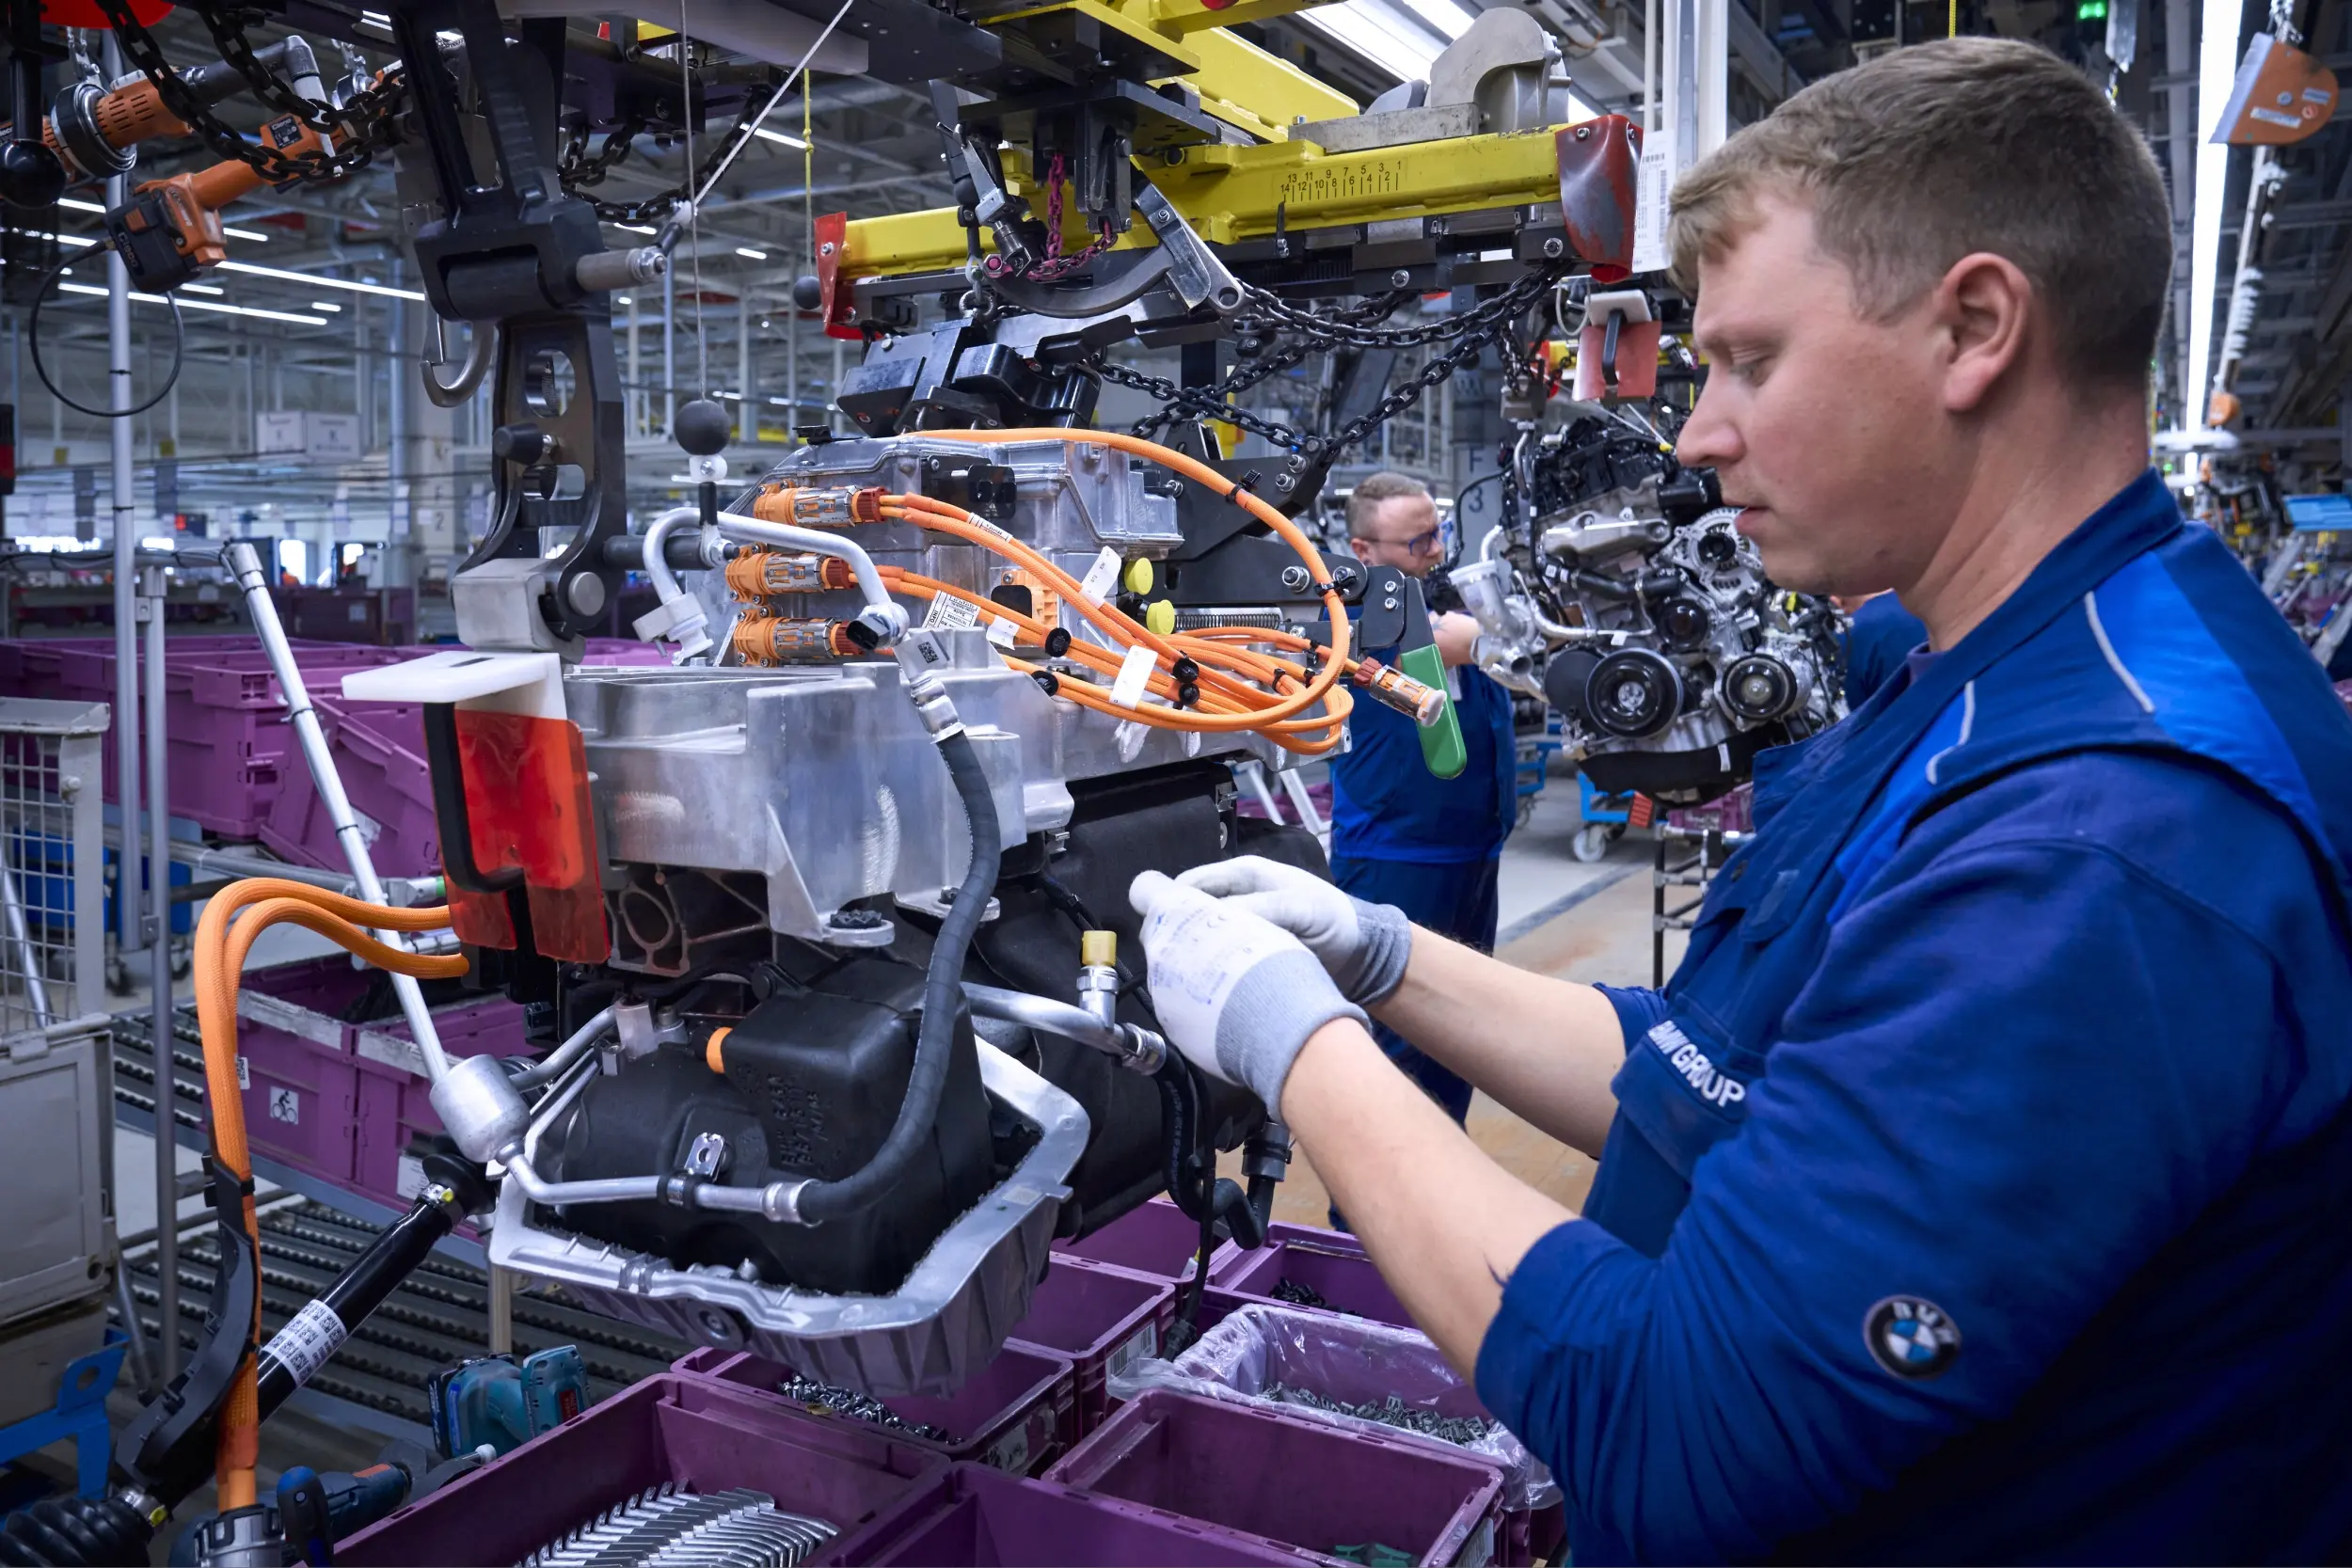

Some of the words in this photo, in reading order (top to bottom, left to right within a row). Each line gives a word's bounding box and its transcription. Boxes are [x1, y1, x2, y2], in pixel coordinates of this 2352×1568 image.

[1280, 184, 1290, 193] 14
[1297, 182, 1307, 191] 12
[1315, 180, 1325, 189] 10
[1332, 178, 1338, 187] 8
[1349, 176, 1355, 185] 6
[1367, 173, 1373, 182] 4
[1385, 171, 1391, 181] 2
[1288, 174, 1297, 182] 13
[1305, 171, 1313, 181] 11
[1326, 169, 1331, 179] 9
[1343, 166, 1349, 177] 7
[1360, 165, 1366, 174] 5
[1379, 163, 1384, 172] 3
[1470, 445, 1483, 473] F
[1469, 485, 1483, 513] 3
[435, 511, 444, 532] 2
[930, 610, 939, 624] INFO
[1892, 1301, 1954, 1344] BMW
